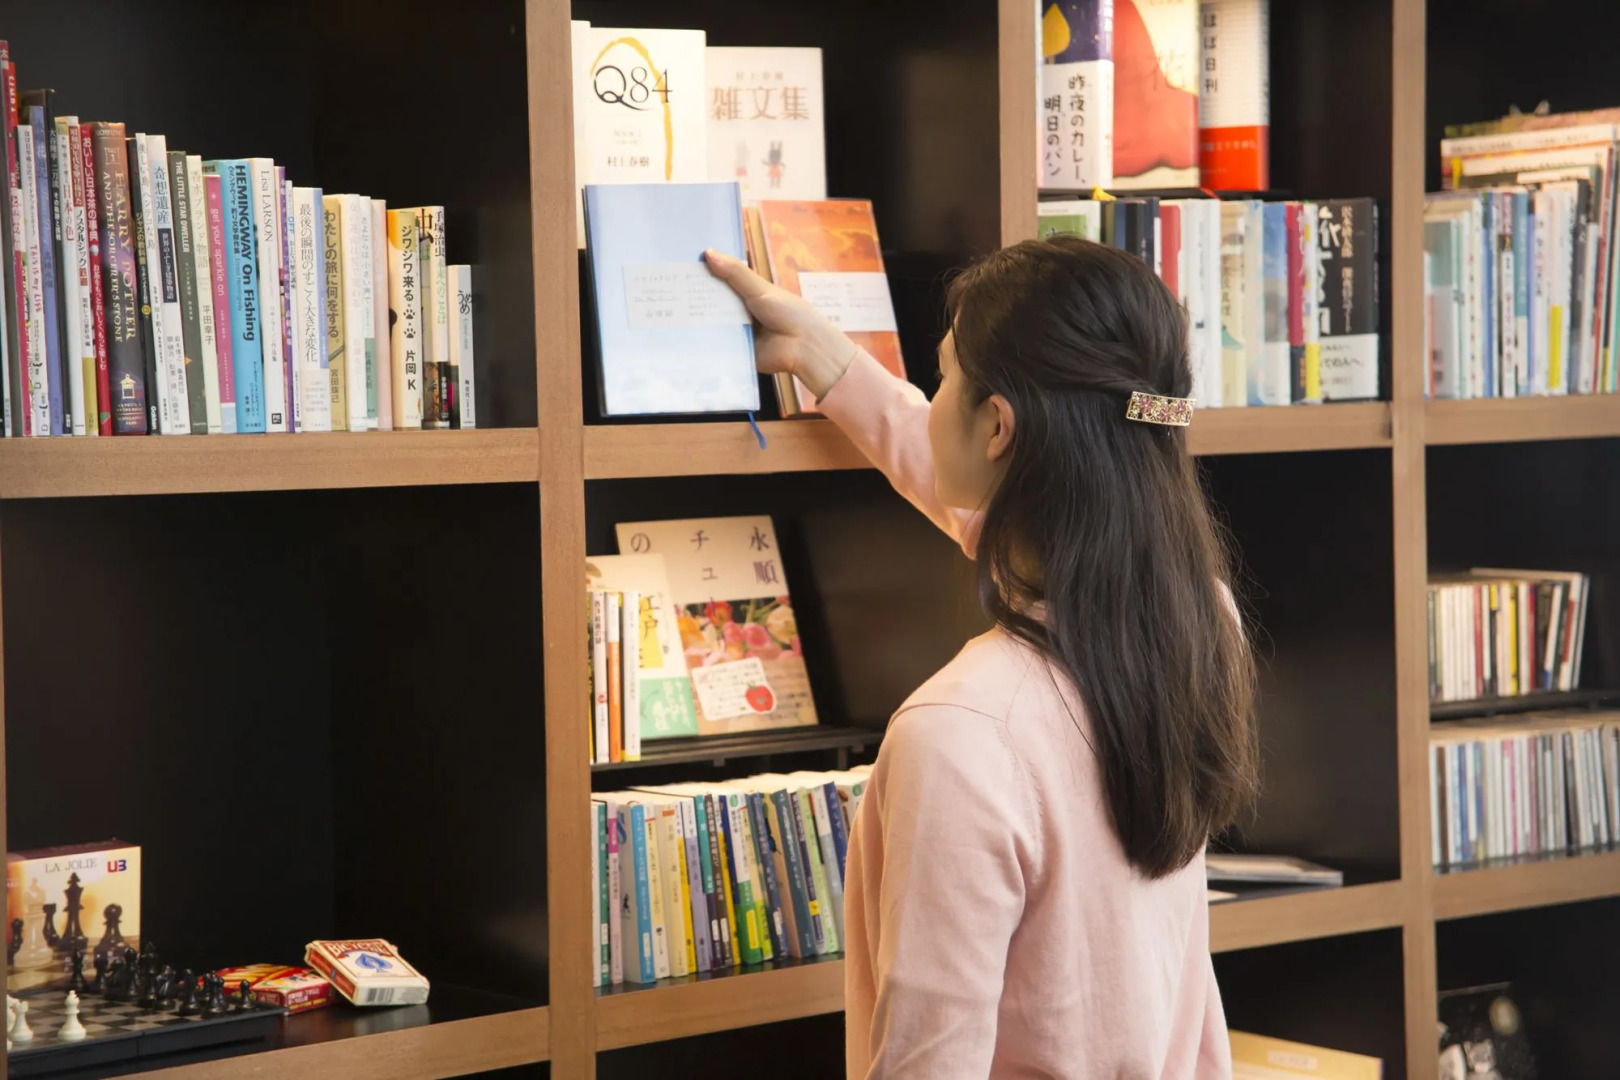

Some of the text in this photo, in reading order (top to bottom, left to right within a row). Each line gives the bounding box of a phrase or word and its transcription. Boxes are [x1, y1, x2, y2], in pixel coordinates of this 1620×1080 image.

[711, 86, 810, 120] 雑文集
[1044, 94, 1061, 176] 明日のパン
[1068, 73, 1087, 184] 昨夜のカレー、
[82, 137, 98, 241] おいしい日本茶の事典
[153, 166, 170, 225] 奇想遺産
[176, 178, 185, 200] LITTLE
[607, 156, 650, 167] 村上春樹
[63, 184, 76, 241] 日本の色
[179, 200, 187, 219] STAR
[180, 220, 190, 253] DWELLER
[260, 170, 273, 242] Lisa LARSON
[103, 171, 122, 343] AND THE SORCERER'S STONE
[115, 170, 136, 340] HARRY POTTER
[210, 208, 225, 296] get your sparkle on
[235, 165, 255, 341] HEMINGWAY On Fishing
[299, 203, 318, 362] 最後の瞬間のすごく大きな変化
[323, 209, 340, 343] わたしの旅に何をする。
[405, 349, 417, 391] 片岡 K
[45, 858, 97, 873] LA JOLIE
